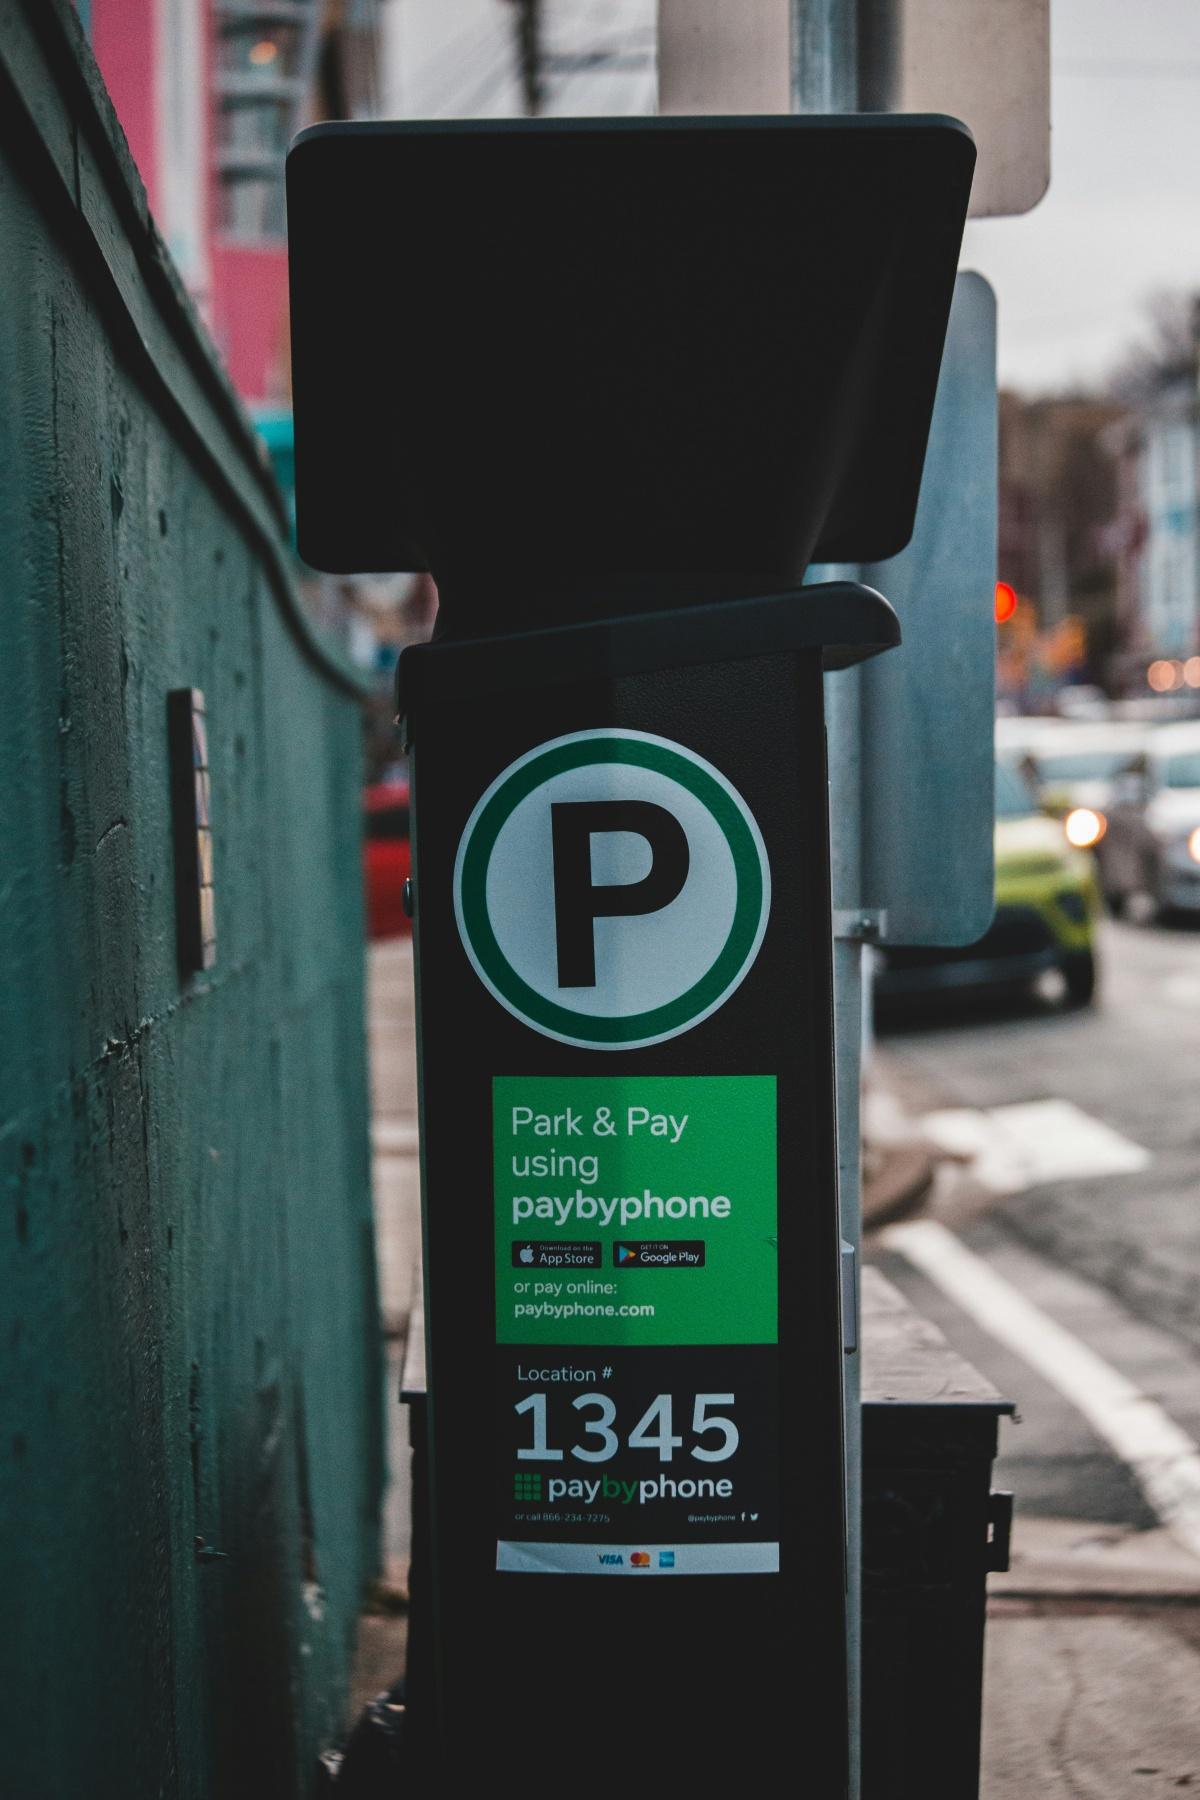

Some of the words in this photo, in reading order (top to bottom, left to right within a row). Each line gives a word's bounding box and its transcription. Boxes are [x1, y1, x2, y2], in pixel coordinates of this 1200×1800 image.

[551, 800, 690, 988] P
[511, 1107, 584, 1136] Park
[593, 1107, 617, 1136] &
[627, 1107, 689, 1143] Pay
[512, 1148, 599, 1184] using
[512, 1189, 731, 1226] paybyphone
[540, 1253, 562, 1266] App
[565, 1253, 594, 1264] Store
[641, 1252, 677, 1264] Google
[679, 1252, 700, 1264] Play
[514, 1281, 530, 1294] or
[534, 1283, 562, 1297] pay
[567, 1280, 617, 1294] online:
[515, 1302, 655, 1318] paybyphone.com
[517, 1365, 596, 1382] Location
[602, 1367, 613, 1379] #
[514, 1392, 740, 1463] 1345
[549, 1473, 733, 1504] paybyphone
[526, 1513, 541, 1521] call
[598, 1554, 624, 1565] VISA
